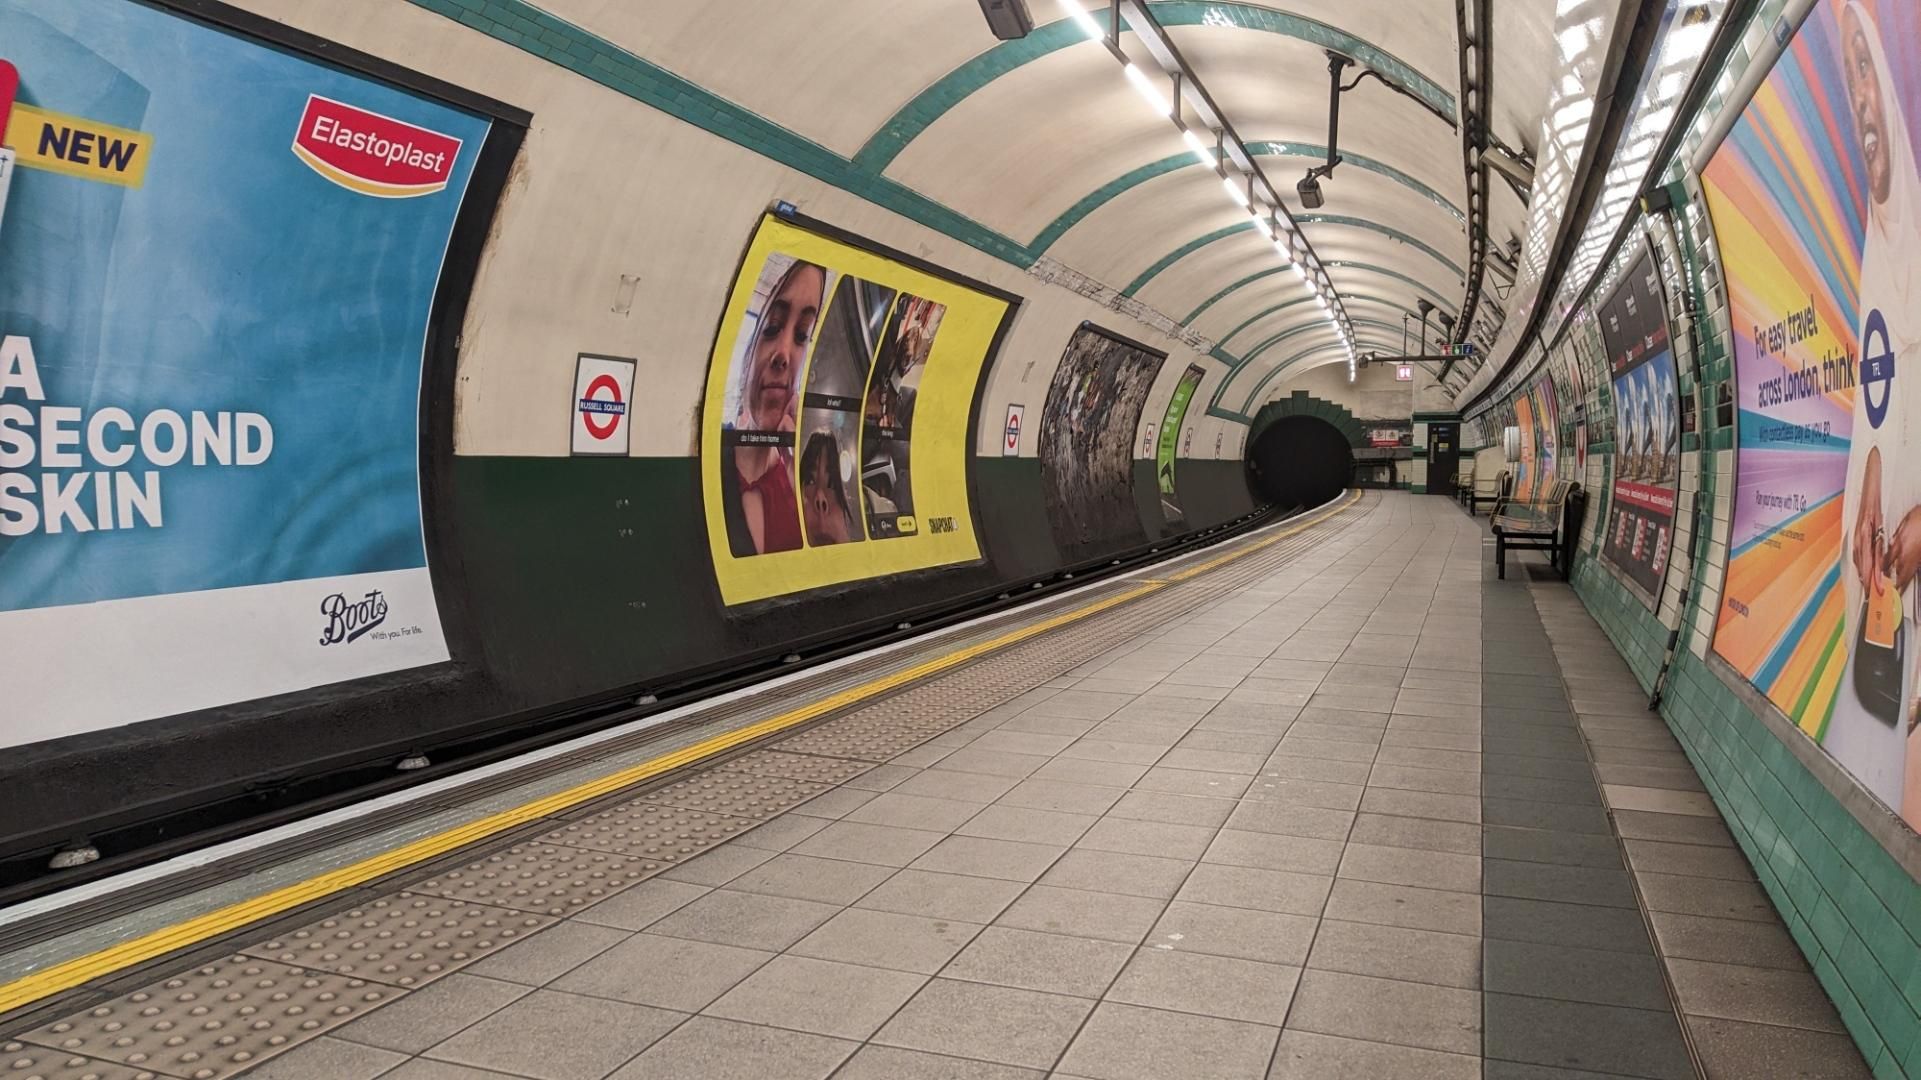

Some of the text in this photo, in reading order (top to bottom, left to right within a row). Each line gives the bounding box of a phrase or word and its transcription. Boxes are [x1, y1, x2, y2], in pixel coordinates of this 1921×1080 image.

[37, 122, 138, 172] NEW
[311, 115, 445, 173] Elastoplast
[1754, 293, 1818, 360] For easy travel
[0, 335, 46, 400] A
[1758, 342, 1855, 408] across London, think
[580, 401, 624, 412] RUSSELL SQUARE
[1823, 420, 1831, 443] go
[0, 404, 274, 468] SECOND
[0, 470, 163, 536] SKIN
[928, 516, 954, 535] SNAPCHAT
[1800, 494, 1807, 513] Go
[319, 589, 388, 646] Boots
[370, 632, 387, 640] With
[401, 627, 411, 637] For
